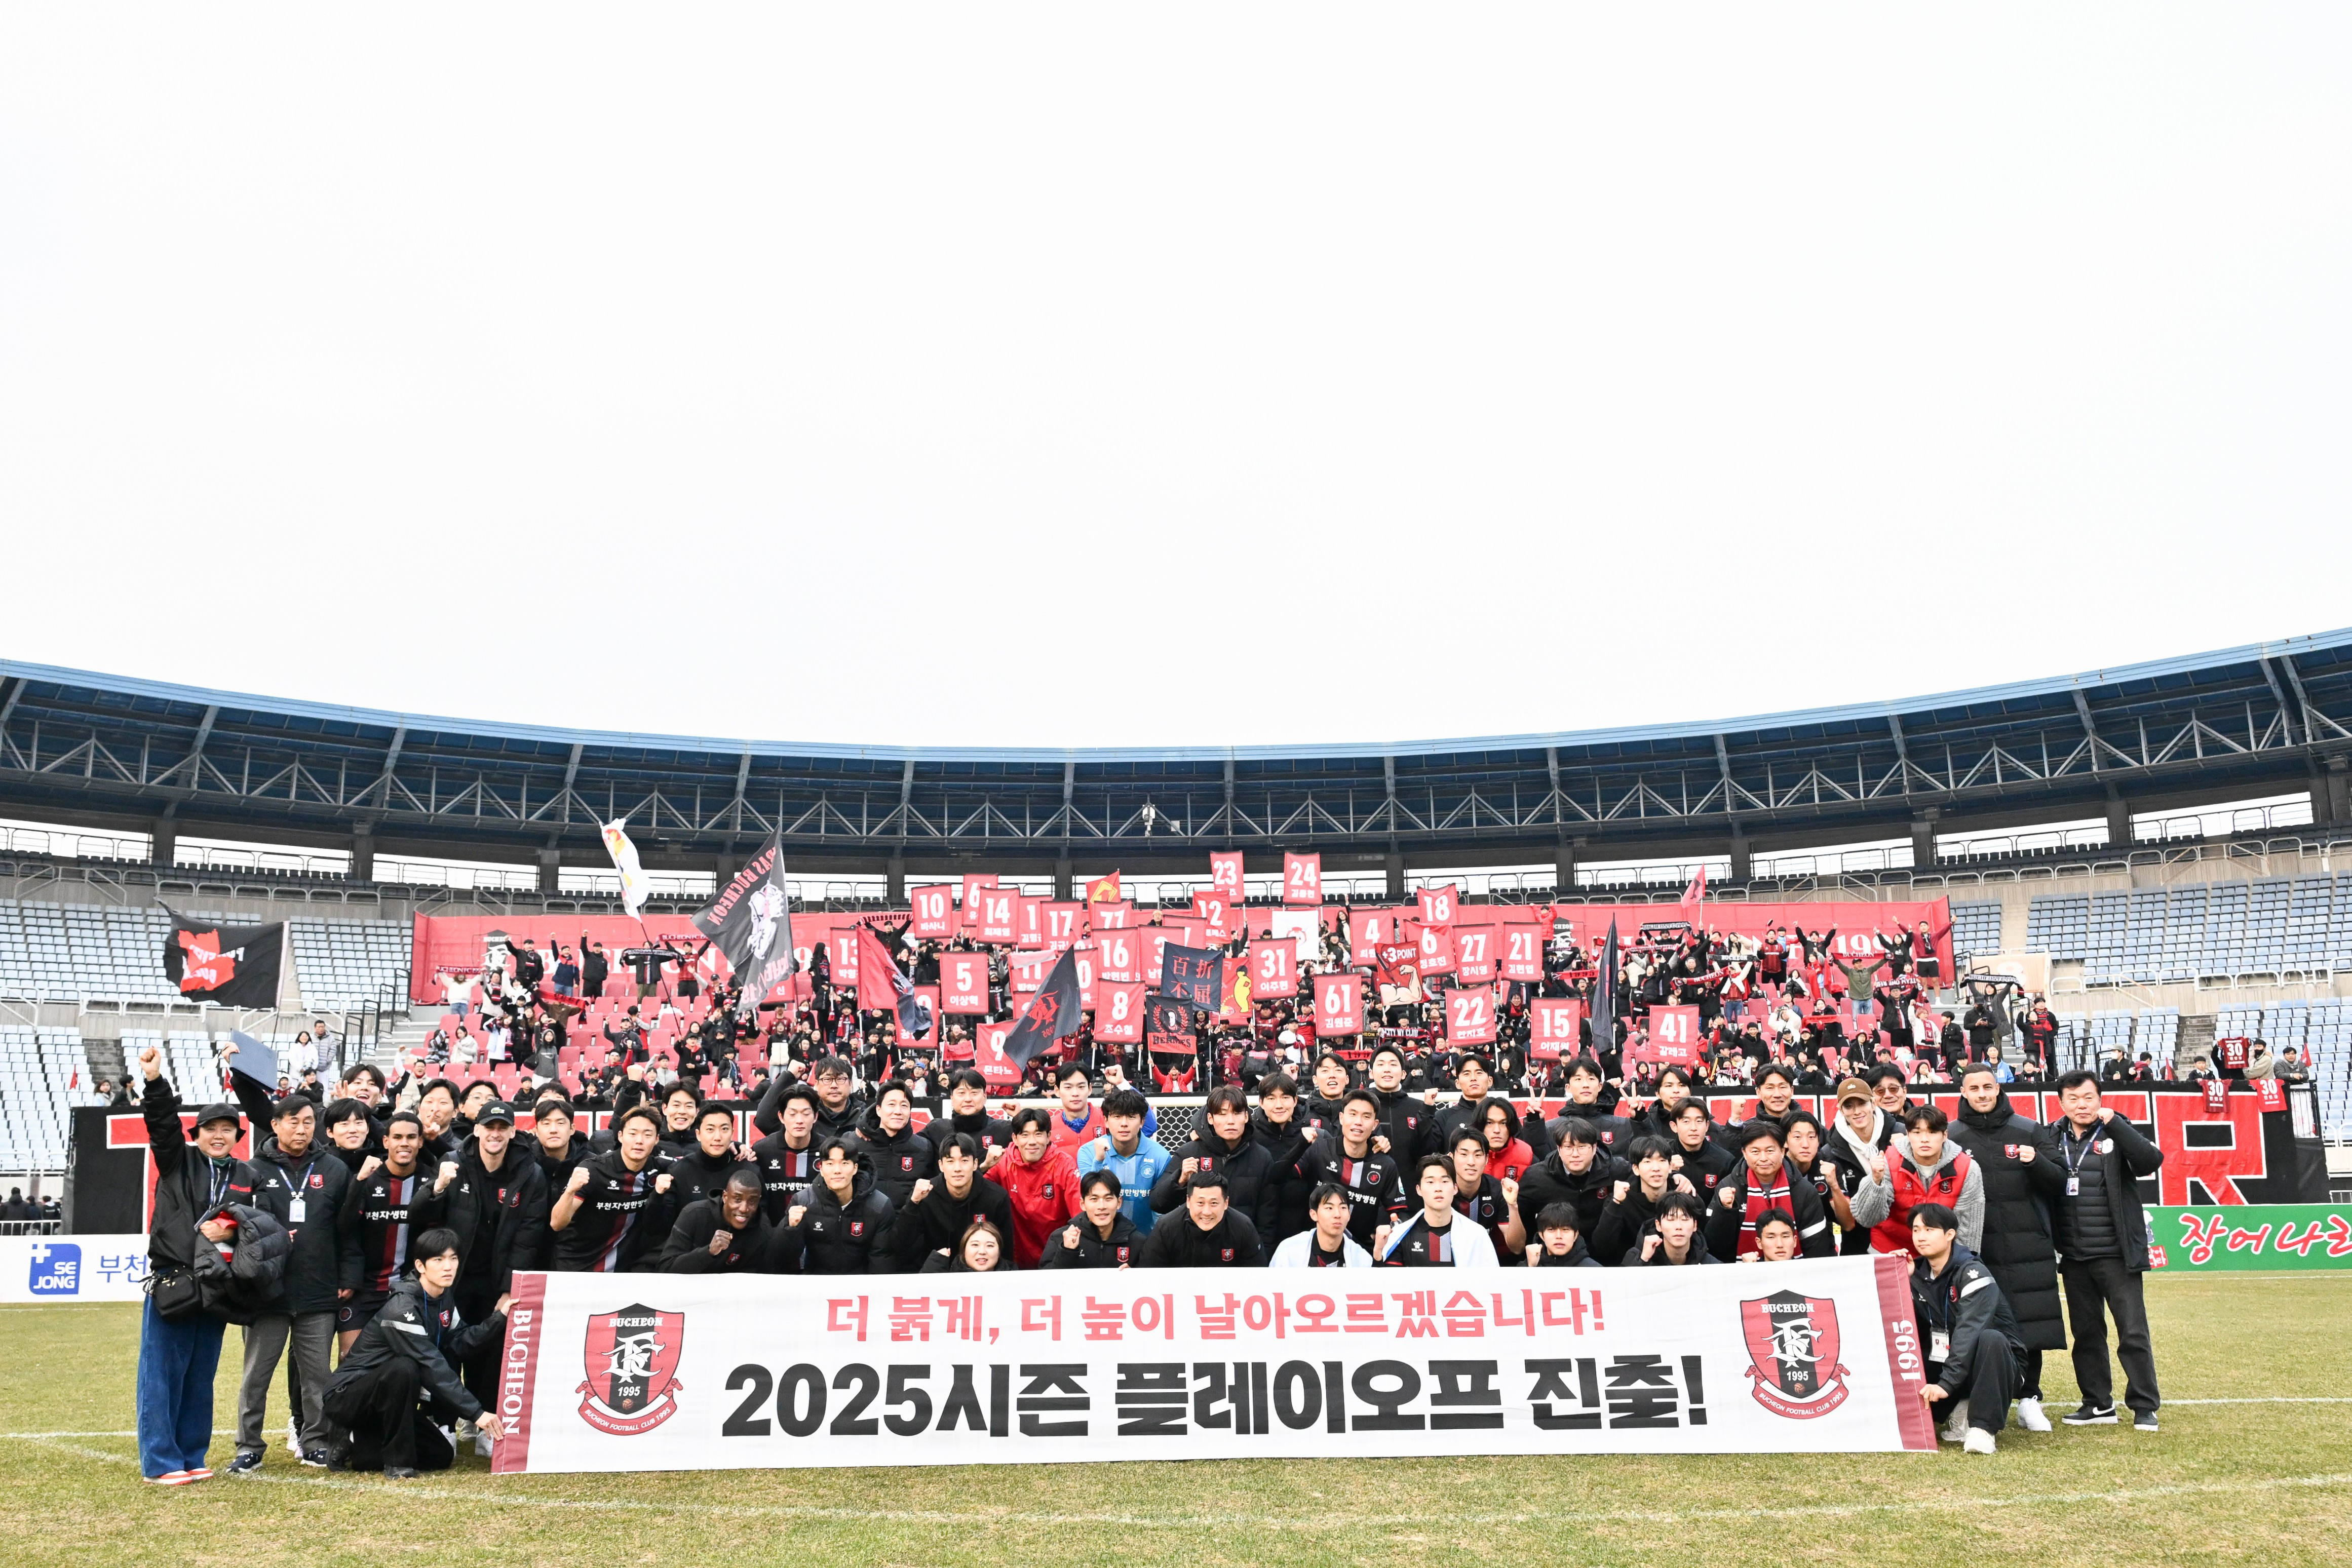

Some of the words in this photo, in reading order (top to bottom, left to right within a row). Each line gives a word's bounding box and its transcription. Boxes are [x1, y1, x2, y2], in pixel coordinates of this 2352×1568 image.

[1214, 860, 1237, 885] 23
[1290, 861, 1317, 887] 24
[919, 893, 944, 918] 10
[986, 897, 1010, 924] 14
[1027, 905, 1036, 930] 1
[1198, 900, 1222, 926] 12
[1424, 894, 1450, 922] 18
[920, 921, 945, 931] 바사니
[1049, 911, 1073, 936] 17
[1365, 919, 1380, 944] 4
[1101, 939, 1128, 968] 16
[1421, 927, 1437, 955] 6
[1460, 934, 1486, 962] 27
[1508, 932, 1532, 960] 21
[1260, 949, 1285, 978] 31
[1397, 948, 1417, 960] POINT
[956, 963, 972, 992] 5
[1076, 960, 1091, 989] 0
[1173, 955, 1214, 979] 百折
[1461, 965, 1487, 976] 장시영
[1693, 970, 1724, 983] BUCHEON
[1171, 981, 1211, 1004] 不屈
[1260, 981, 1288, 992] 이주현
[1325, 984, 1351, 1014] 61
[949, 995, 979, 1006] 이상혁
[1111, 991, 1128, 1020] 8
[1453, 997, 1487, 1027] 22
[1104, 1024, 1133, 1036] 조수철
[1325, 1017, 1354, 1029] 김원준
[1405, 1029, 1418, 1037] CLUB
[1540, 1008, 1570, 1038] 15
[1659, 1013, 1687, 1043] 41
[990, 1031, 1006, 1061] 9
[1152, 1035, 1191, 1048] HERMES
[1659, 1046, 1687, 1057] 갈레고
[2226, 1043, 2243, 1056] 30
[984, 1065, 1013, 1076] 몬타뇨
[2208, 1081, 2224, 1096] 30
[2260, 1079, 2278, 1094] 30
[54, 1261, 76, 1275] SE
[33, 1275, 75, 1289] JONG
[827, 1295, 868, 1342] 더
[888, 1295, 999, 1345] 붉게,
[1020, 1295, 1061, 1341] 더
[1081, 1293, 1174, 1340] 높이
[1194, 1288, 1605, 1340] 날아오르겠습니다!
[1761, 1303, 1815, 1313] BUCHEON
[608, 1317, 664, 1327] BUCHEON
[1892, 1320, 1922, 1382] 1995
[502, 1309, 532, 1435] BUCHEON
[1787, 1371, 1809, 1381] 1995
[618, 1386, 640, 1397] 1995
[722, 1363, 1091, 1437] 2025시즌
[1115, 1359, 1505, 1434] 플레이오프
[1524, 1355, 1708, 1430] 진출!
[1759, 1392, 1785, 1411] BUCHEON
[1786, 1406, 1815, 1415] FOOTBALL
[1816, 1402, 1830, 1413] CLUB
[1829, 1392, 1844, 1406] 1995
[584, 1408, 609, 1428] BUCHEON
[609, 1423, 639, 1432] FOOTBALL
[640, 1418, 656, 1429] CLUB
[656, 1407, 672, 1422] 1995
